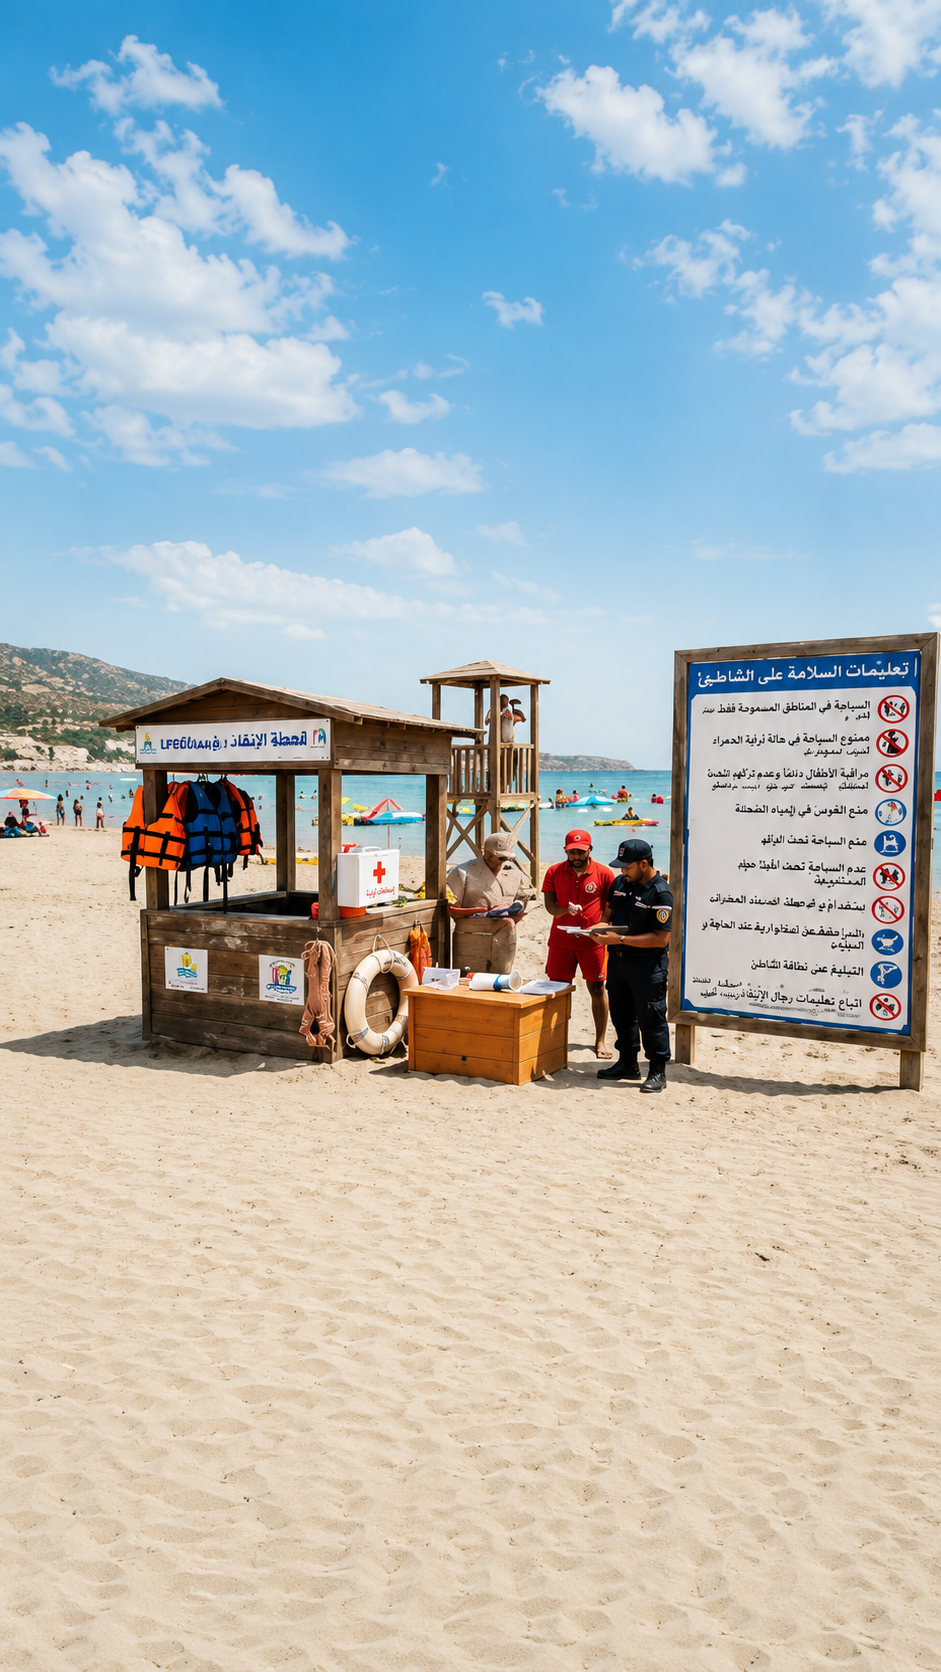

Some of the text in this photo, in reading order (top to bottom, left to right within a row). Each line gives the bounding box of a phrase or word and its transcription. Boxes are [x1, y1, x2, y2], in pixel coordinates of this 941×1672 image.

[757, 667, 783, 685] على
[788, 665, 842, 680] السلامة
[818, 700, 832, 714] في
[798, 804, 812, 818] في
